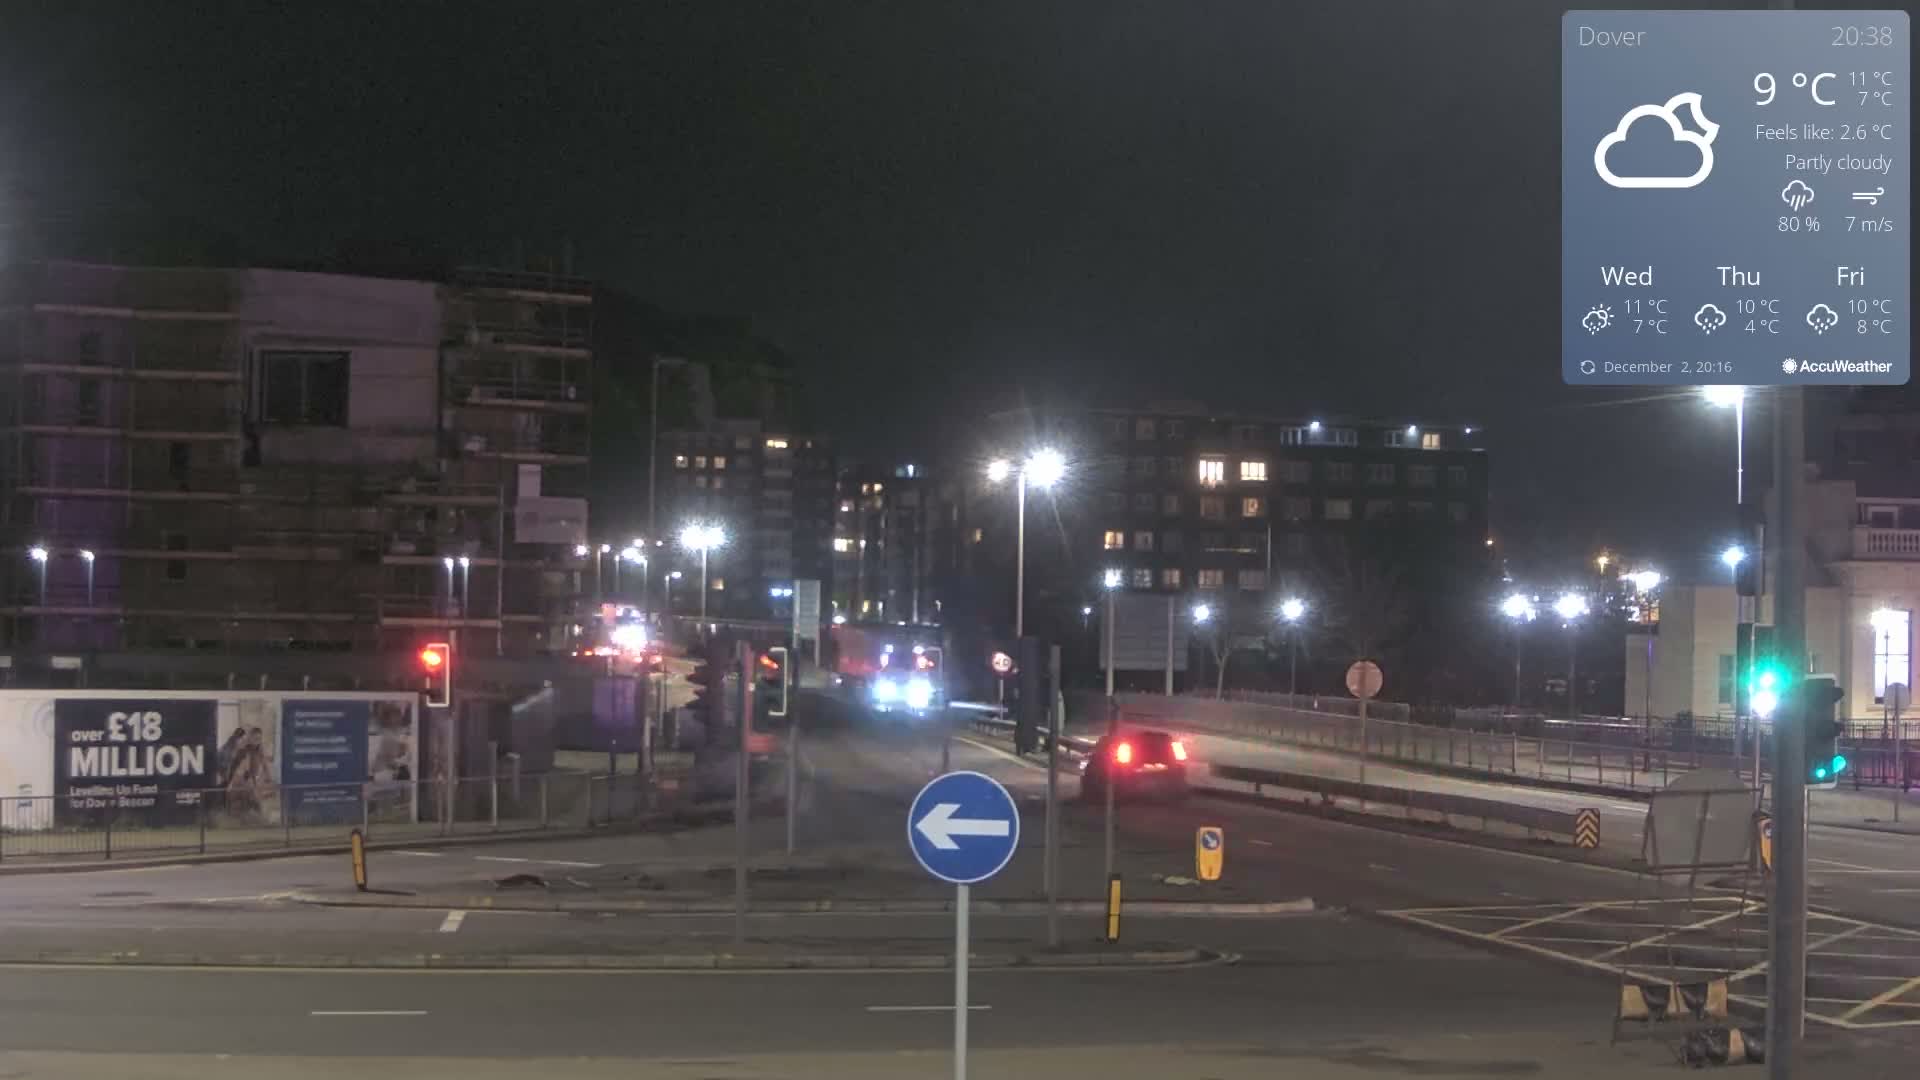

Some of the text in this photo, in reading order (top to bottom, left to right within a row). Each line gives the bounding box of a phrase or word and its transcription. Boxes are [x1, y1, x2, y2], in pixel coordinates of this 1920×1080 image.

[71, 711, 162, 742] over £18
[71, 745, 204, 777] MILLION
